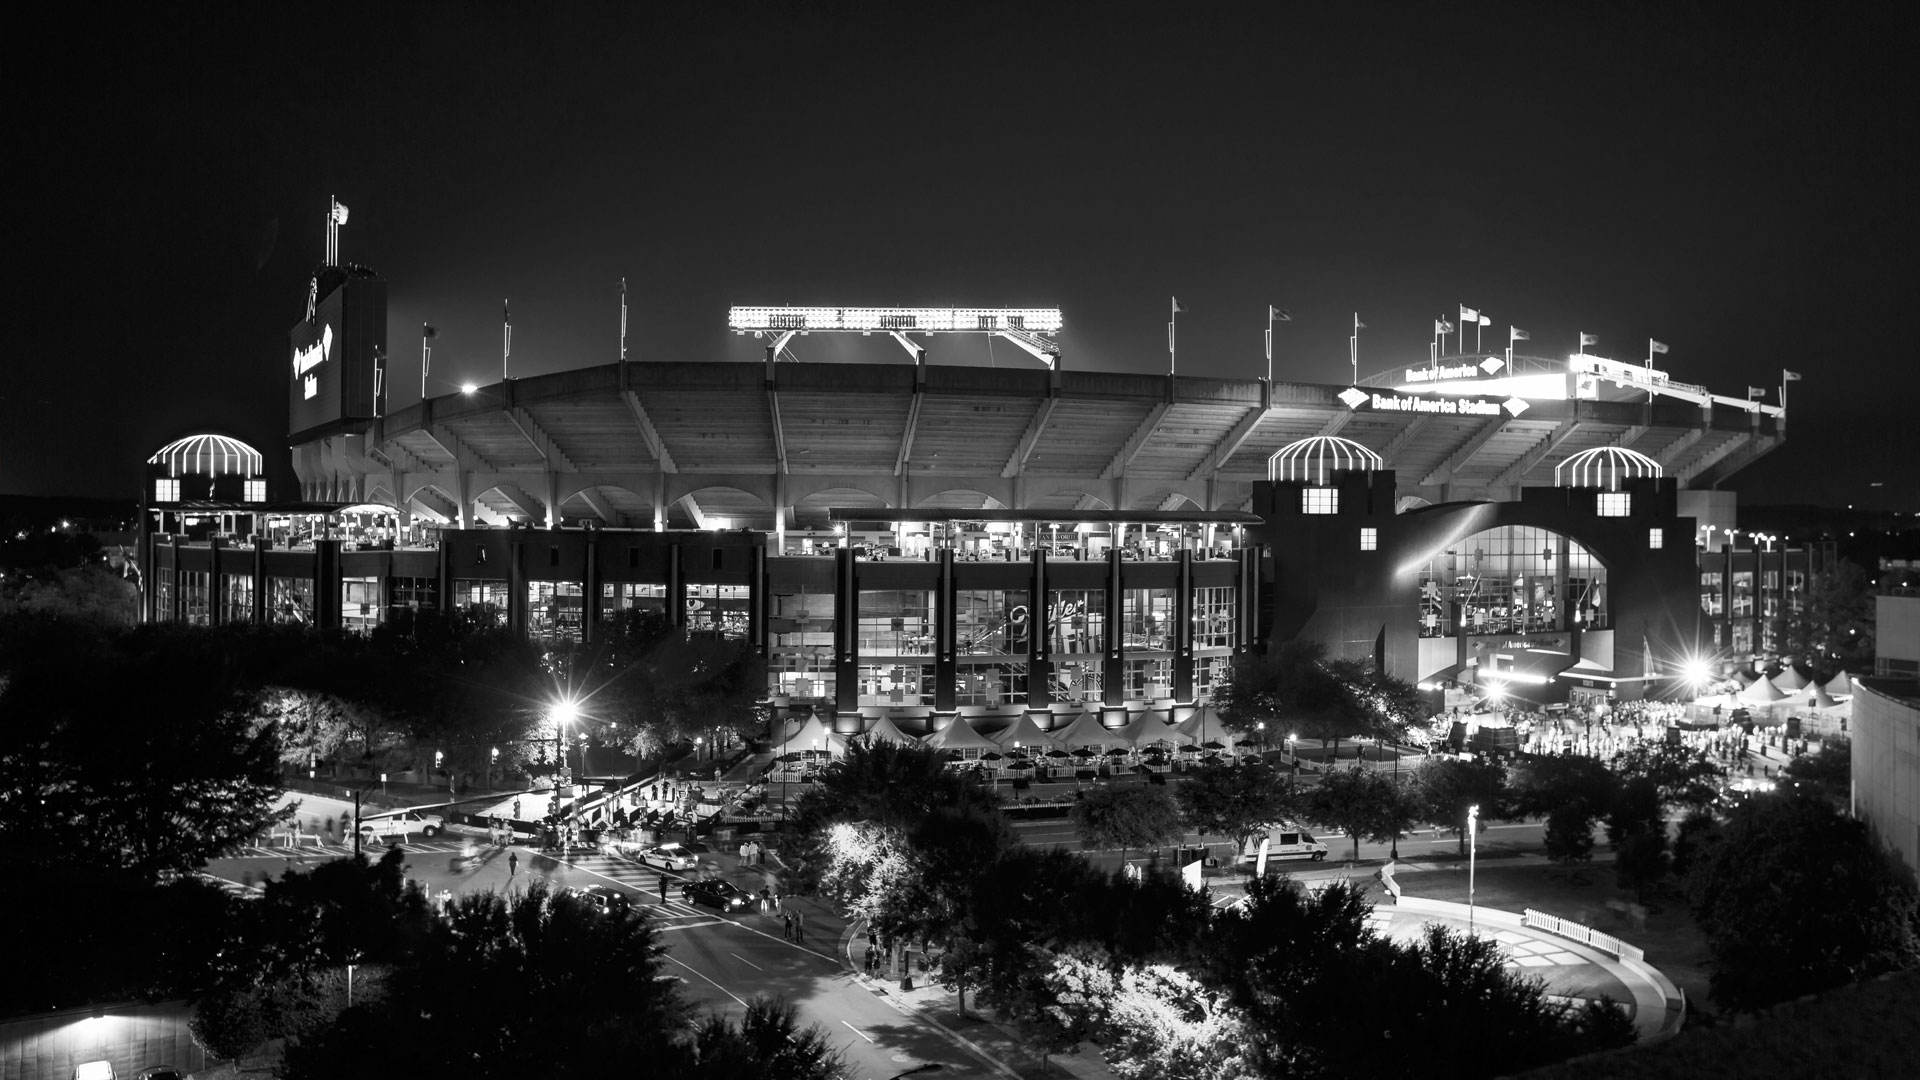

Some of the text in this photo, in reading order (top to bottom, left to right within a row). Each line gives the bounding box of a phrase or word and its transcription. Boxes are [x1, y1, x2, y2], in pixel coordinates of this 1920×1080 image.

[1406, 368, 1429, 382] Bank
[1439, 364, 1477, 379] America
[1372, 394, 1500, 415] Bank of America Stadium
